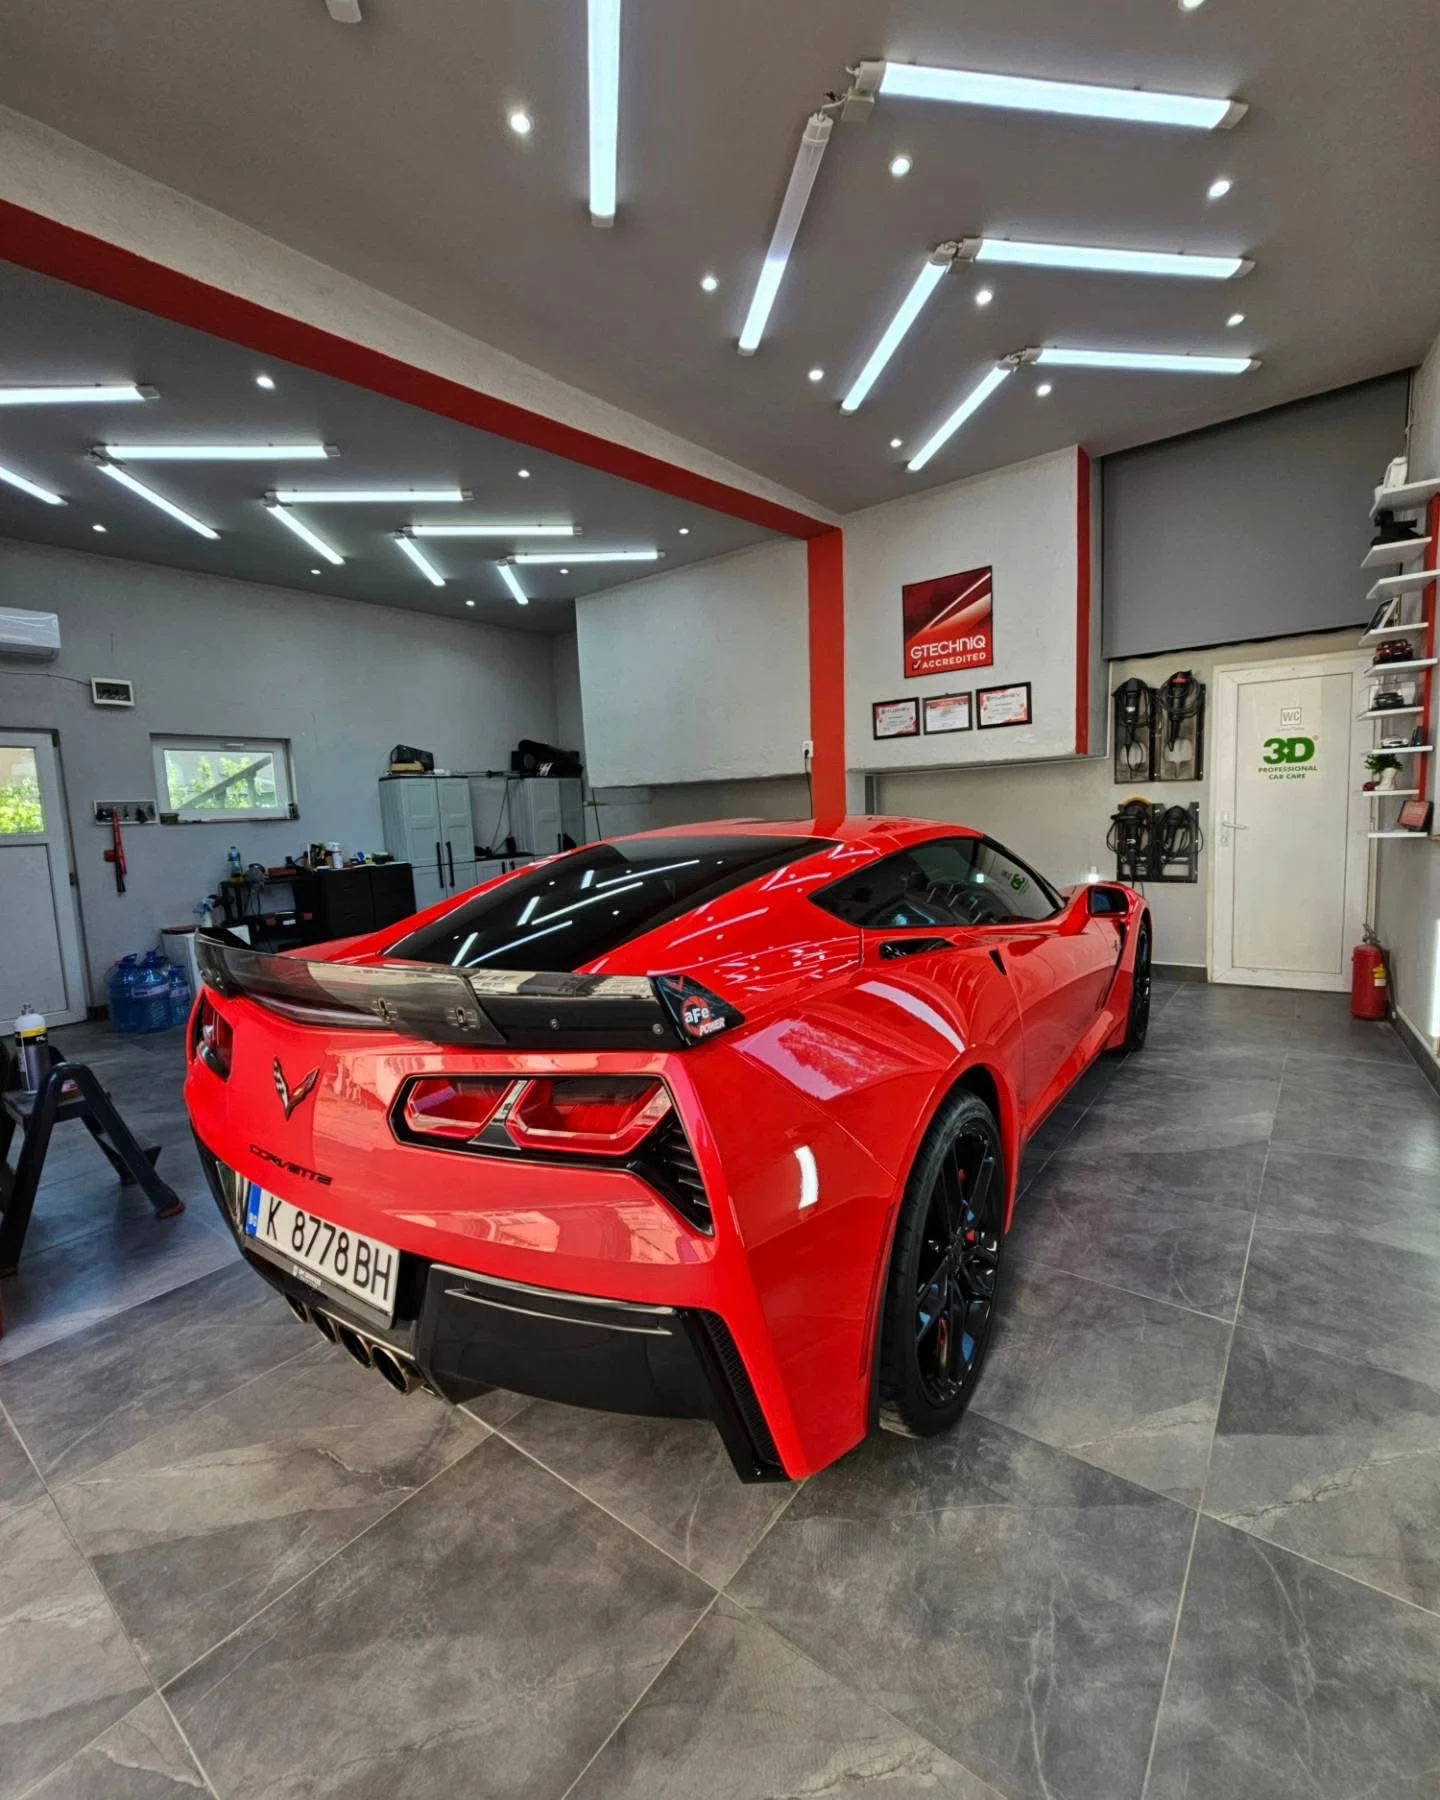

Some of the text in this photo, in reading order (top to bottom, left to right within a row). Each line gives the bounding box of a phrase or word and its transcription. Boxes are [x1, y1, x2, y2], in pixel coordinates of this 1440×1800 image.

[910, 634, 986, 660] GTECHNIQ
[922, 652, 986, 669] ACCREDITED
[1283, 711, 1300, 722] WC
[1263, 737, 1315, 765] 3D
[1258, 765, 1318, 773] PROFESSIONAL
[684, 1007, 710, 1023] aFe
[699, 1016, 726, 1037] POWER
[249, 1143, 333, 1186] CORVETTE
[266, 1196, 282, 1241] K
